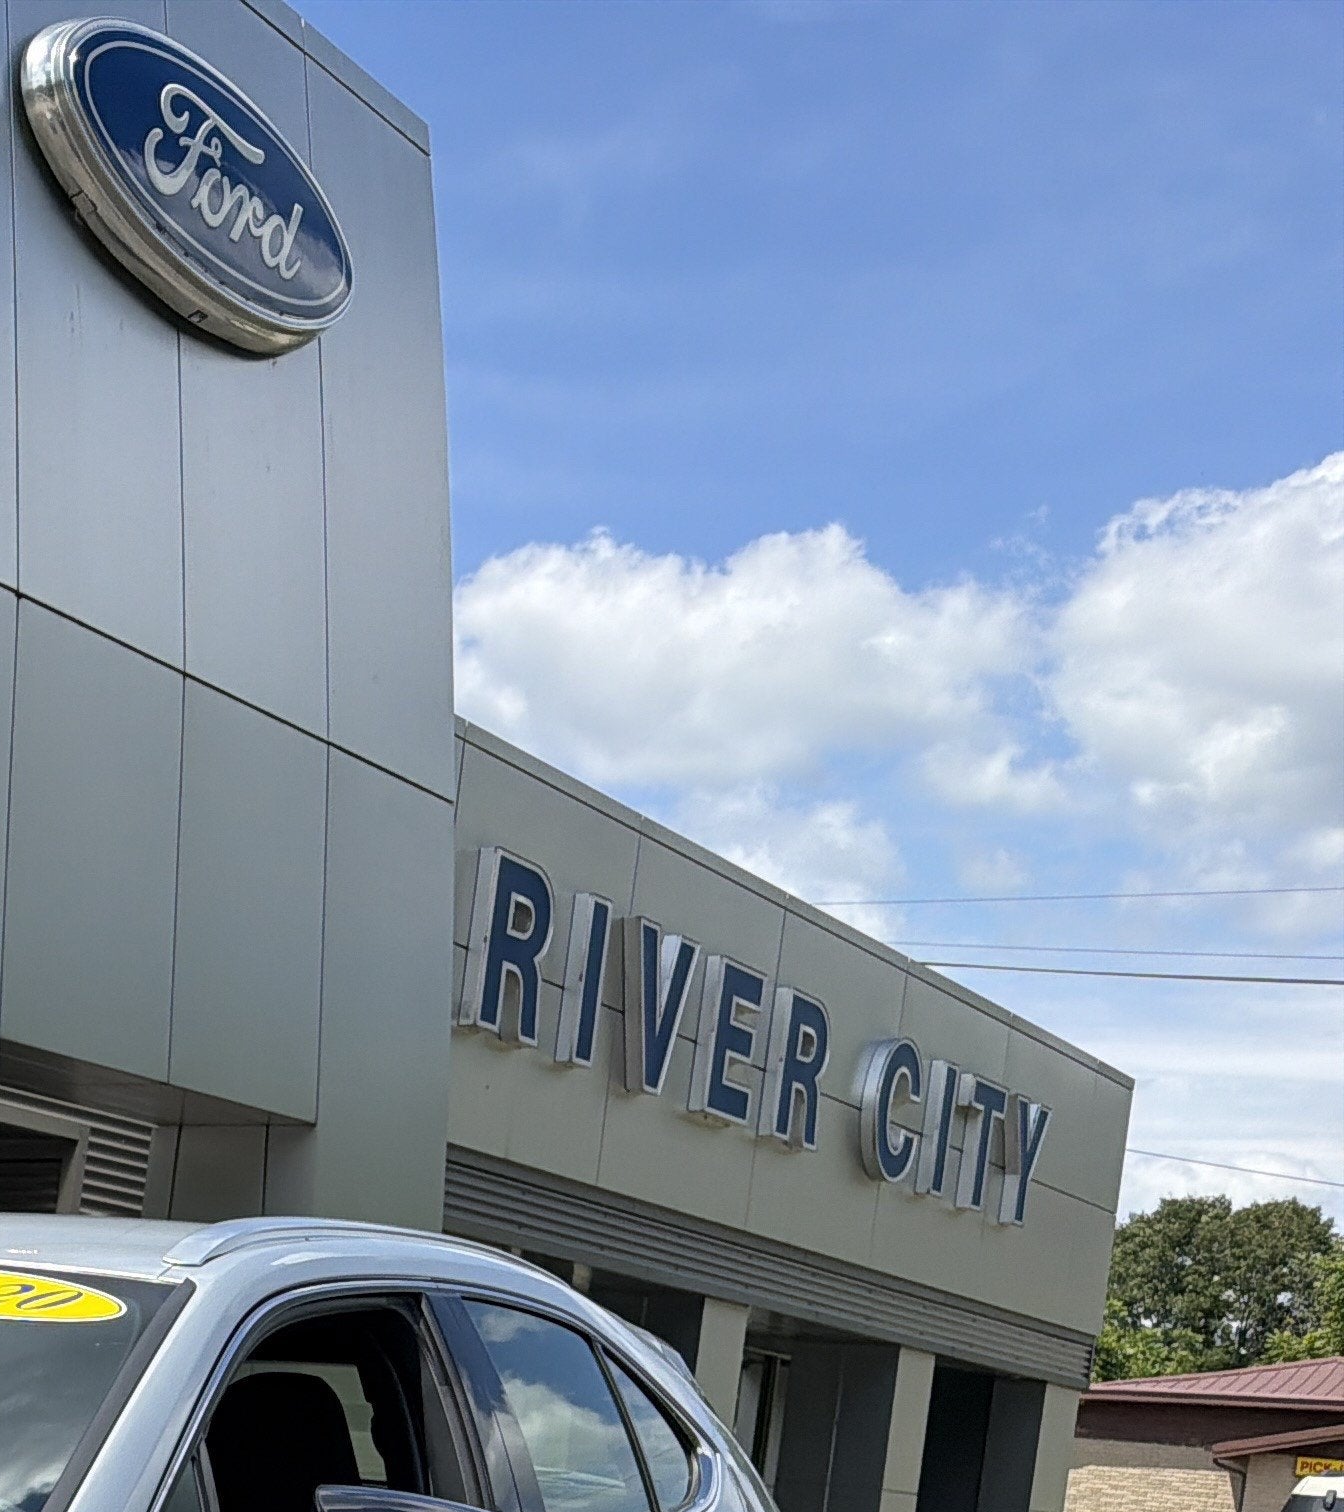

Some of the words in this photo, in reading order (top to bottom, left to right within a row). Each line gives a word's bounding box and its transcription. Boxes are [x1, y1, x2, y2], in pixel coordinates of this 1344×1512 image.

[144, 83, 303, 280] Ford
[460, 847, 830, 1151] RIVER
[859, 1037, 1052, 1226] CITY
